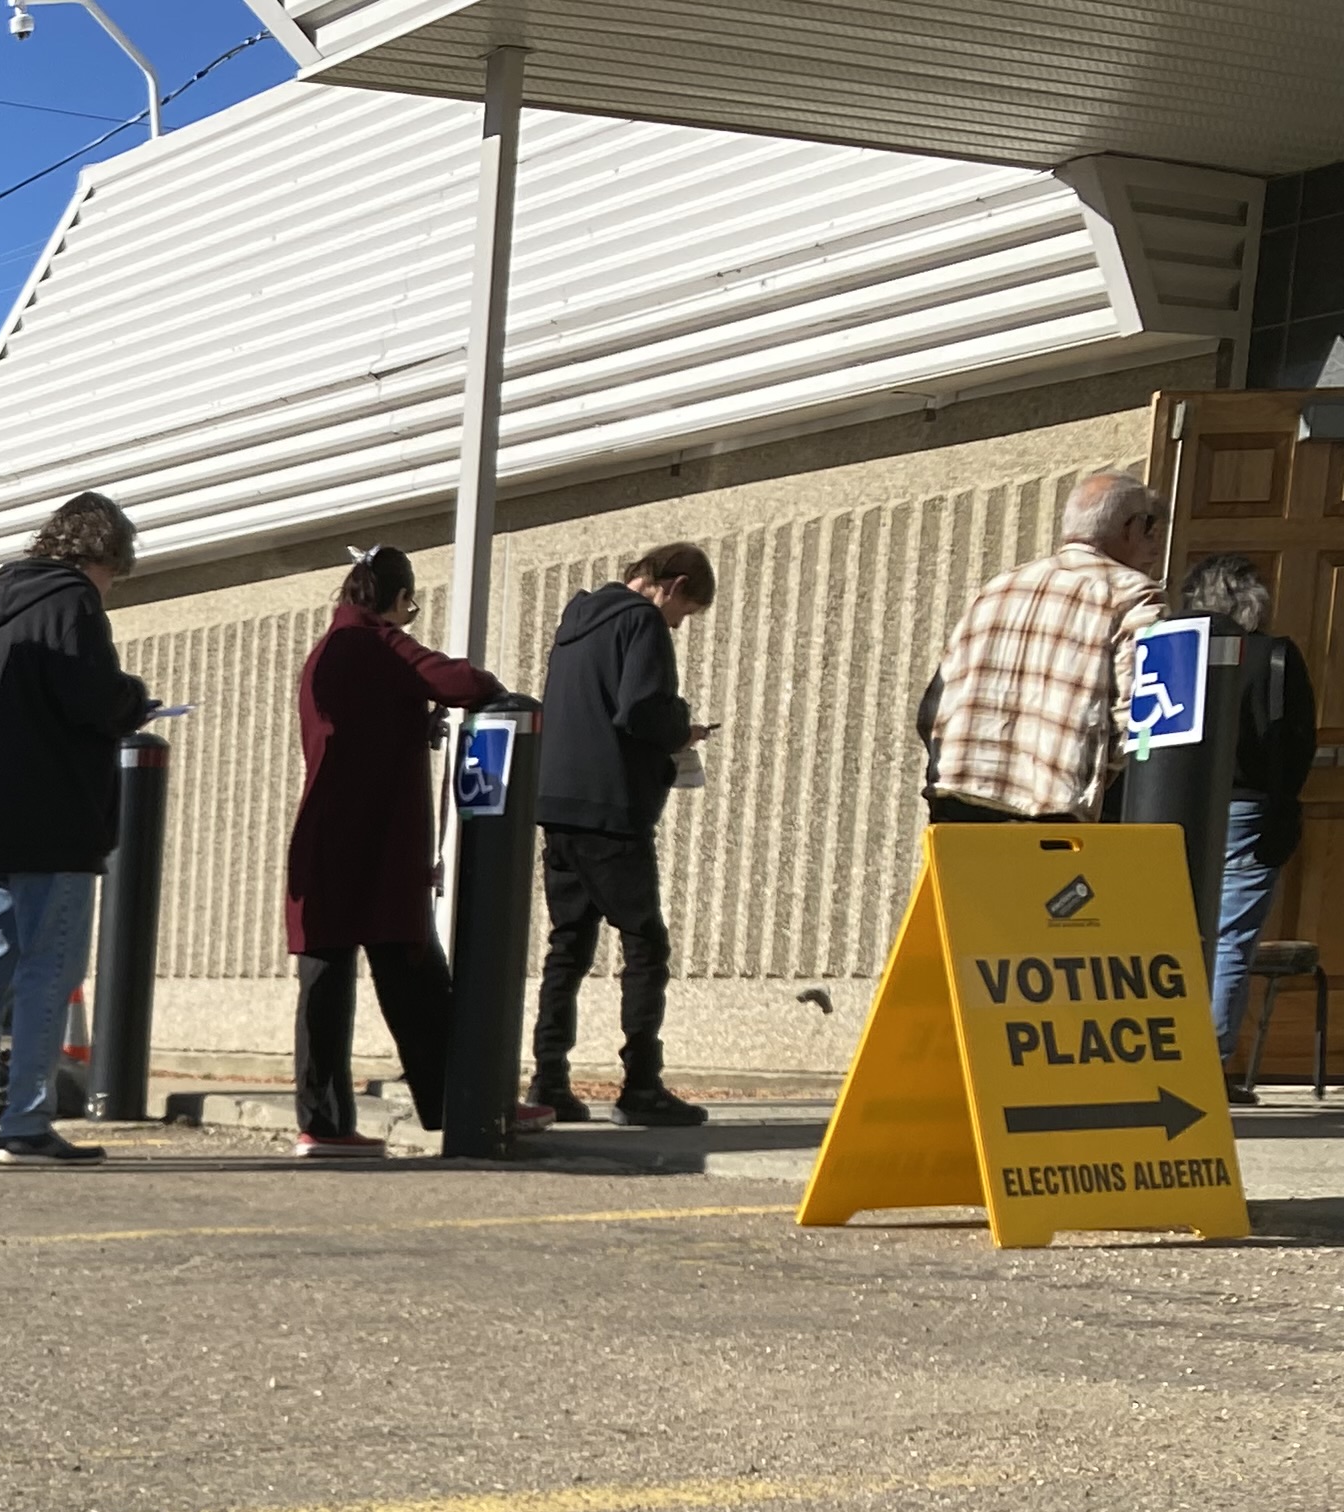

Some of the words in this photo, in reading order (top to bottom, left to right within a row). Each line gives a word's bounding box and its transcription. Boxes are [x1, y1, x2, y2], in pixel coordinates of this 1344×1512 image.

[975, 953, 1188, 1004] VOTING
[1005, 1016, 1183, 1067] PLACE
[1002, 1162, 1127, 1198] ELECTIONS
[1133, 1157, 1232, 1191] ALBERTA
